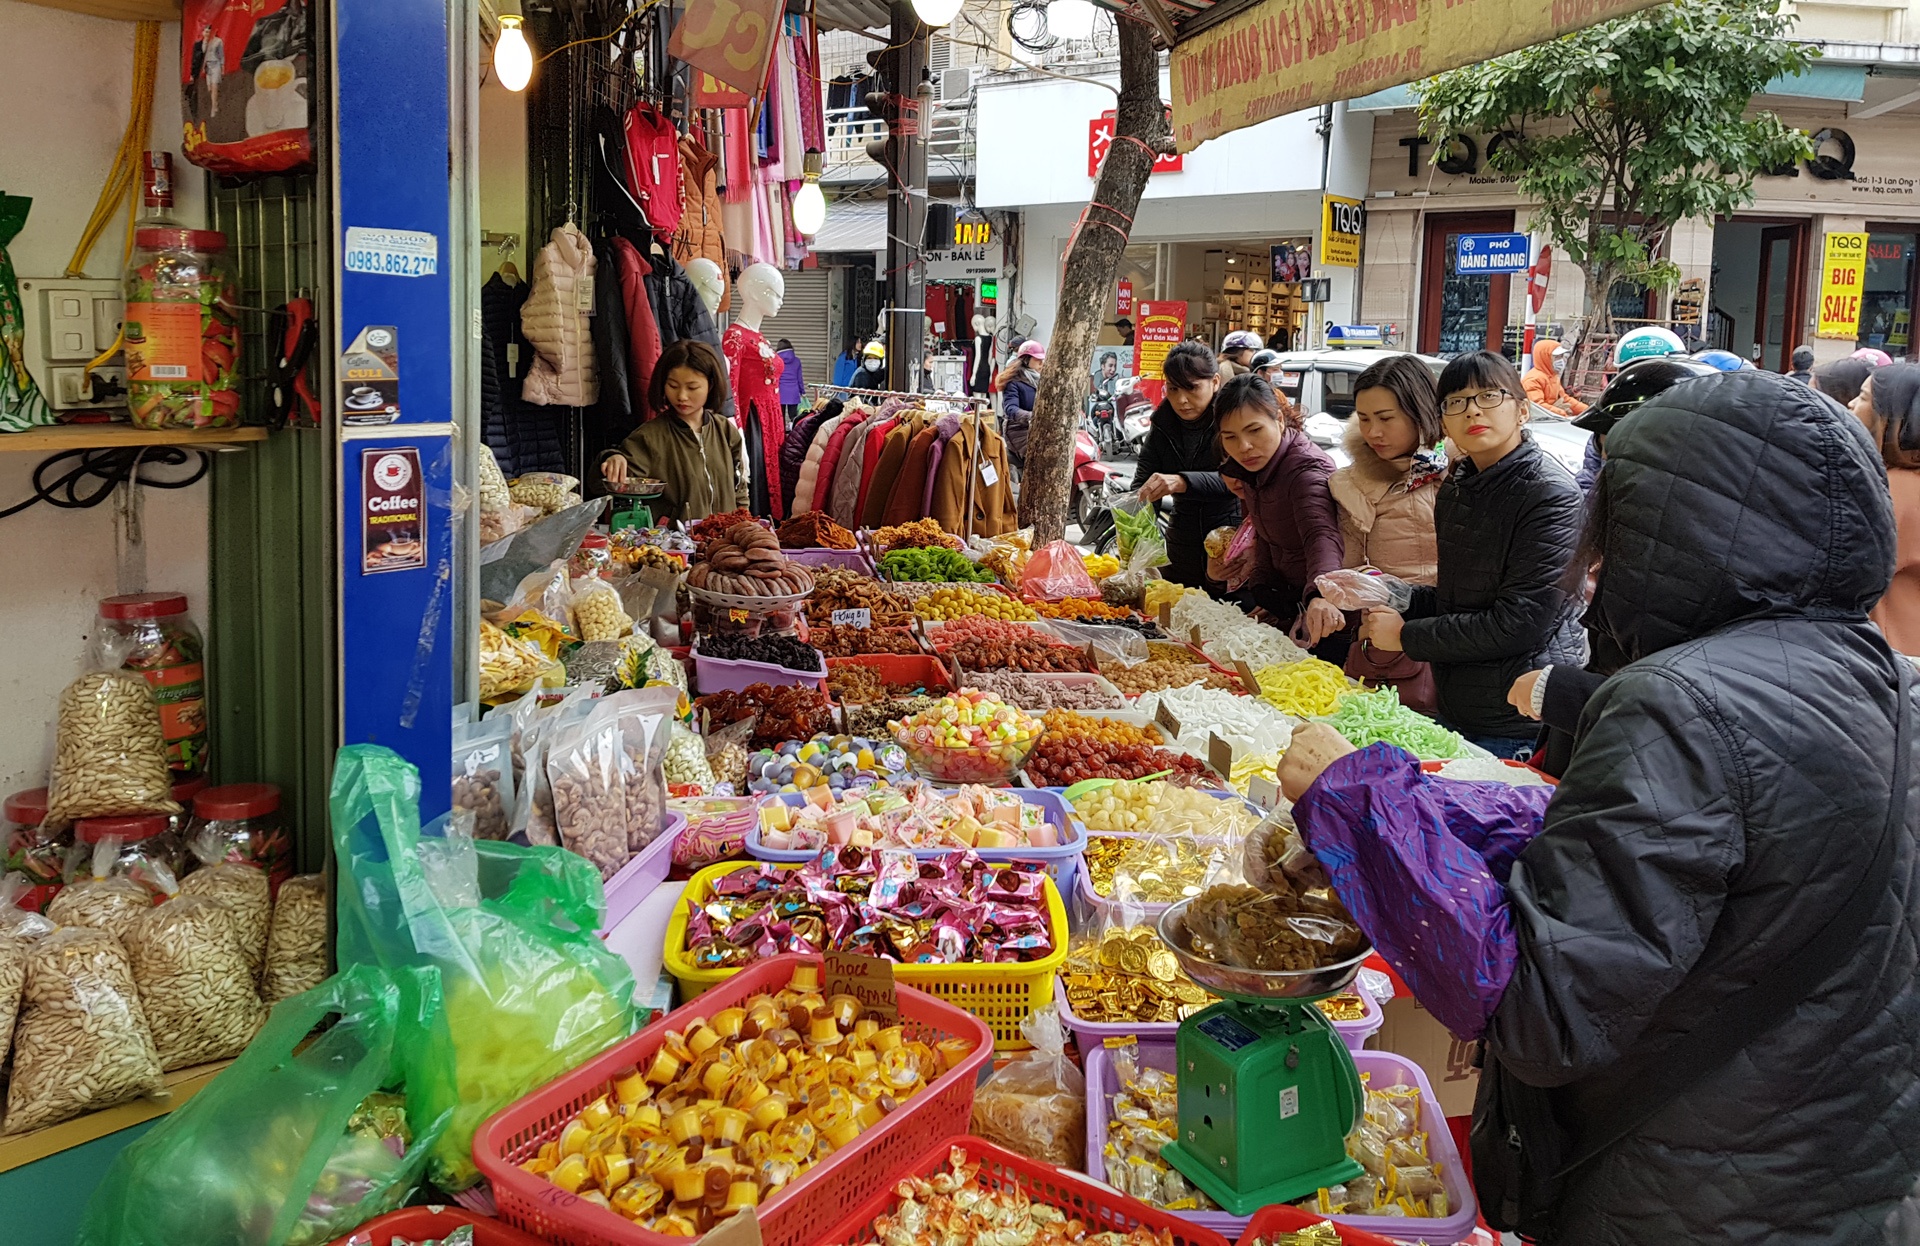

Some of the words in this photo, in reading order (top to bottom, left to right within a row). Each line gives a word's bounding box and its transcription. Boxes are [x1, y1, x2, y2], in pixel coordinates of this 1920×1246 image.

[1333, 202, 1361, 235] TQQ
[1489, 238, 1511, 249] PHỐ
[1831, 236, 1862, 249] TQQ
[1868, 243, 1901, 259] SALE
[1460, 252, 1488, 268] HÀNG
[1489, 252, 1526, 268] NGANG
[1832, 268, 1856, 285] BIG
[1823, 295, 1858, 323] SALE
[347, 368, 383, 379] CULI
[368, 496, 419, 512] Coffee
[369, 513, 418, 525] TRADITIONAL
